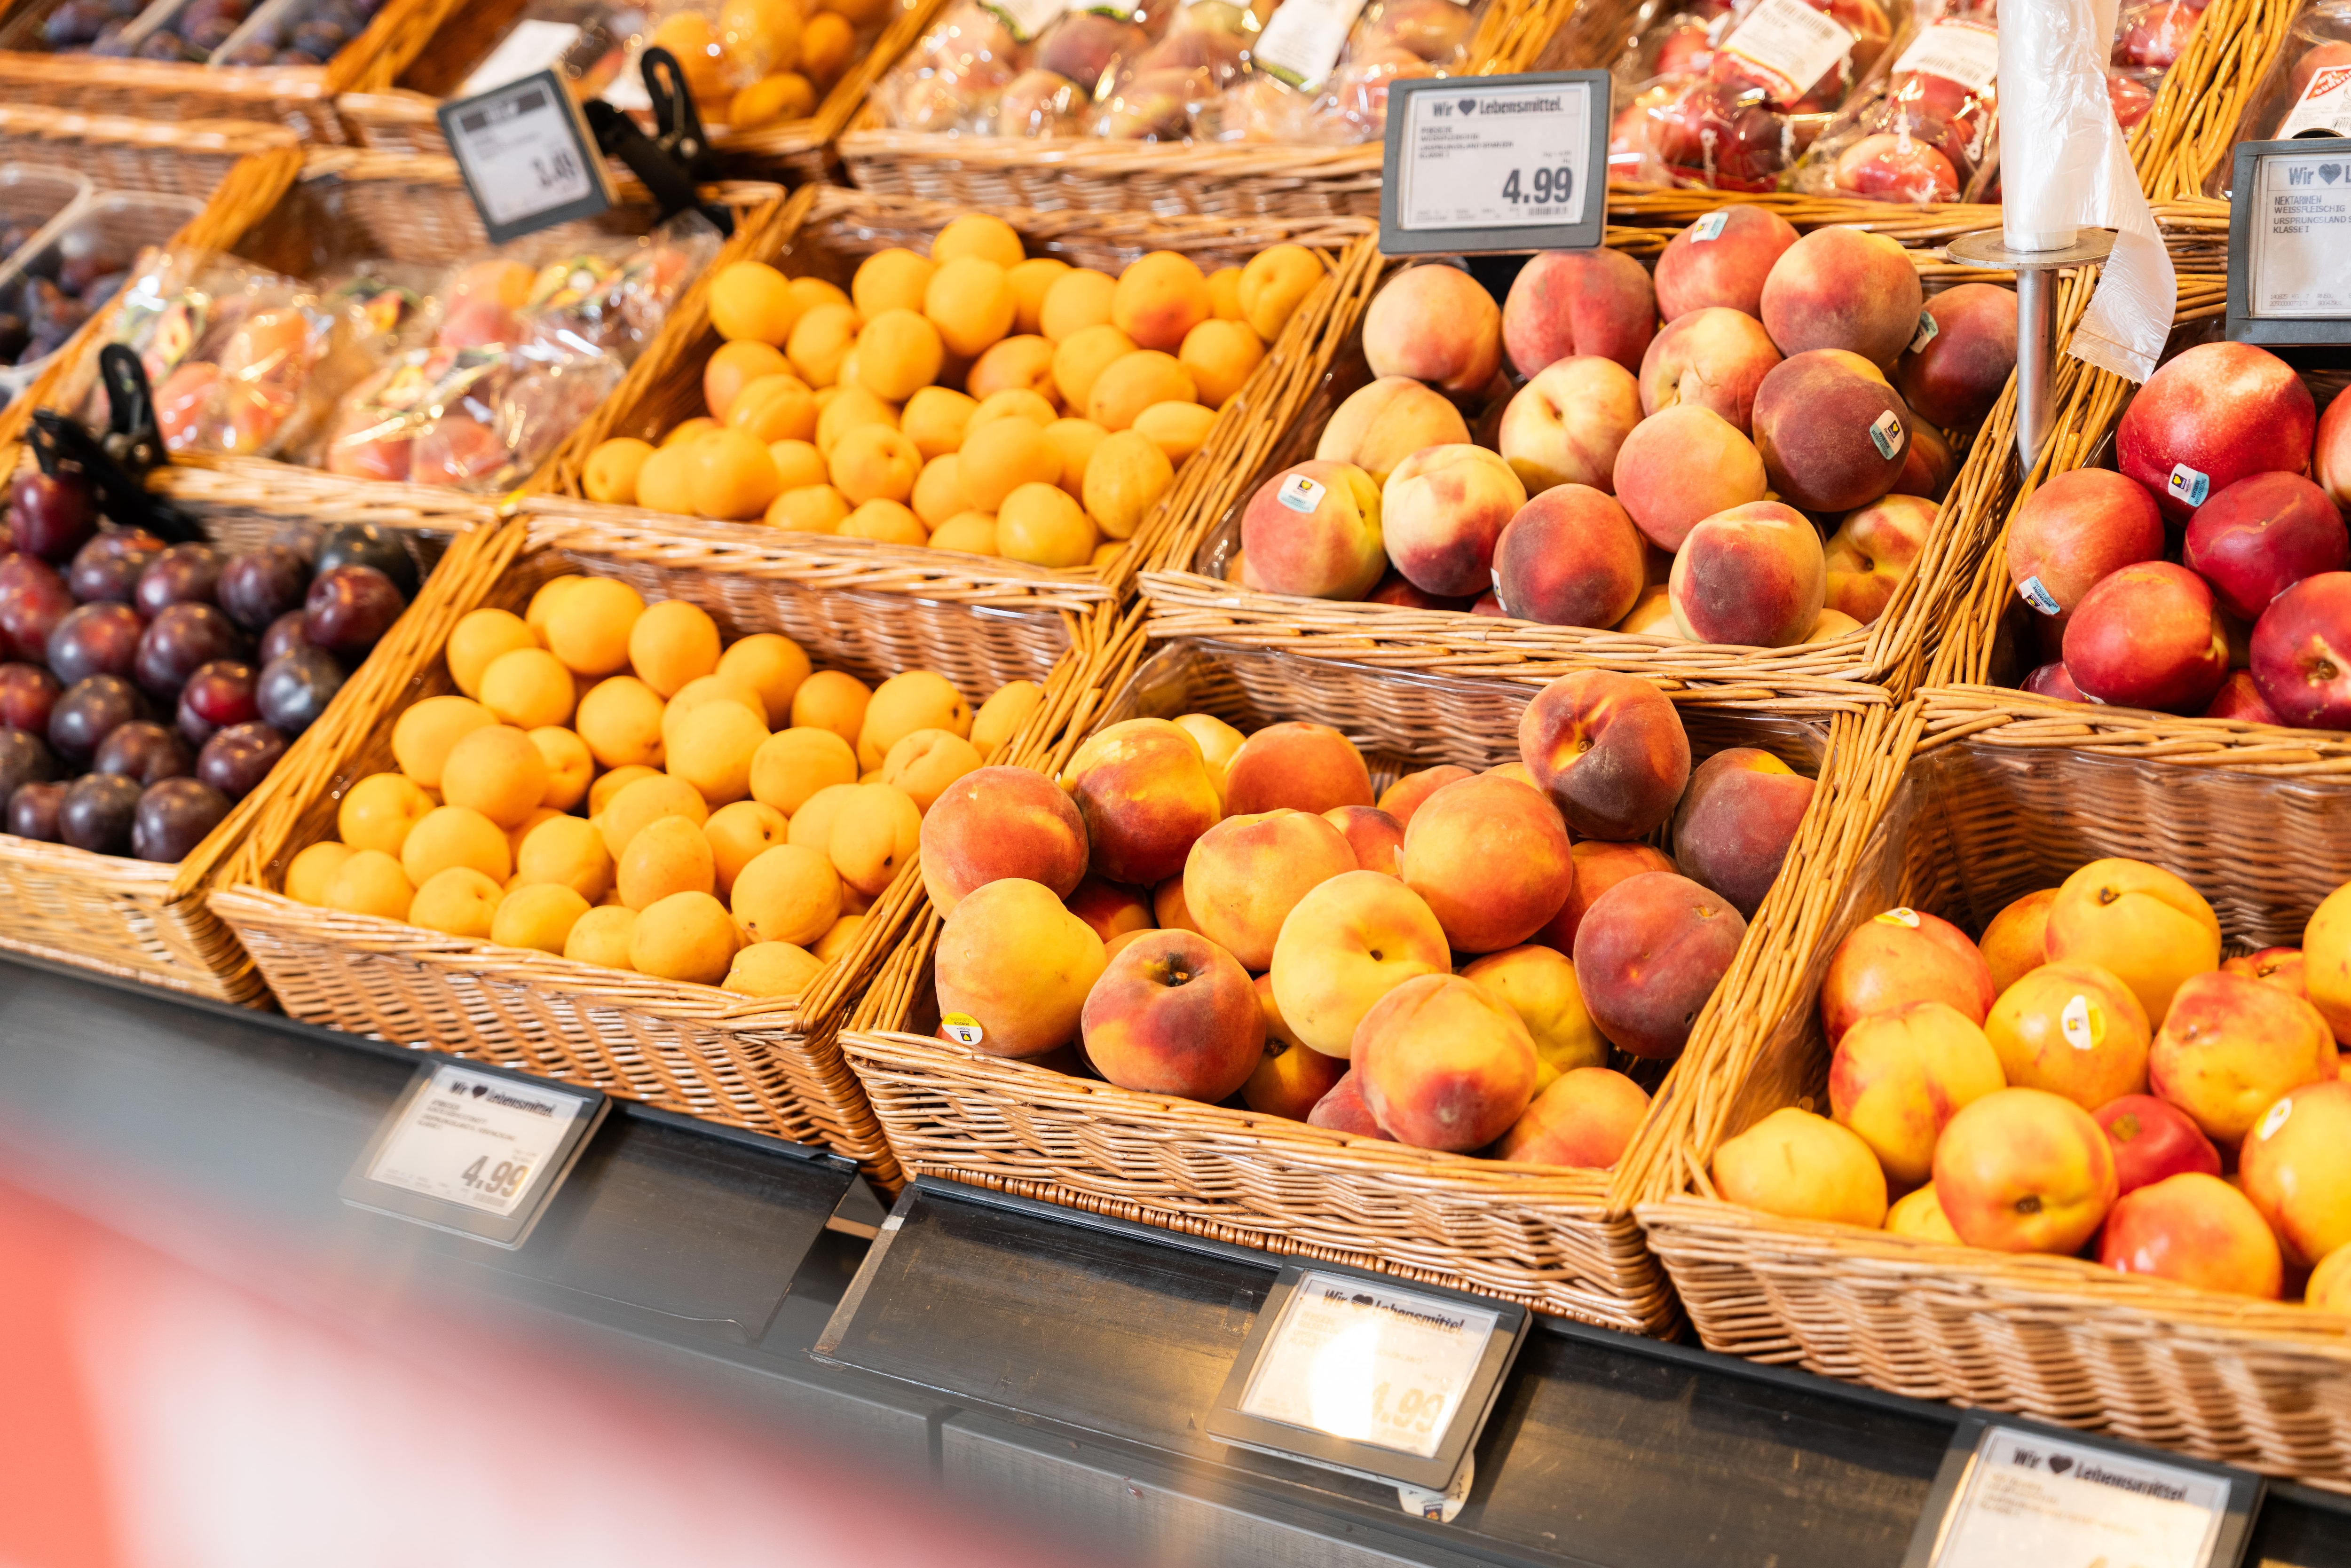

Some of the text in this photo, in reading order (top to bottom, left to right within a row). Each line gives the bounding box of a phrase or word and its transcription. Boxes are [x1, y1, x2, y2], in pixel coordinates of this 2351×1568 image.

[1434, 102, 1453, 116] Wir
[1503, 167, 1572, 203] 4.99
[2289, 166, 2314, 185] Wir
[2274, 195, 2322, 205] NEKTARINEN
[2274, 205, 2345, 213] WEISSFLEISCHIG
[2274, 216, 2347, 224] URSPRUNGSLAND
[1871, 429, 1890, 458] WEISSFLEISCHIG
[2192, 480, 2201, 499] NEKTARINE
[2194, 478, 2207, 504] WEISSFLEISCHIG
[2033, 586, 2052, 607] NEKTARINE
[2034, 580, 2059, 609] WEISSFLEISCHIG
[450, 1080, 469, 1095] Wir
[461, 1155, 529, 1198] 4.99
[1322, 1289, 1348, 1308] Wir
[1373, 1300, 1465, 1336] Lebensmittel.
[2013, 1447, 2041, 1469] Wir
